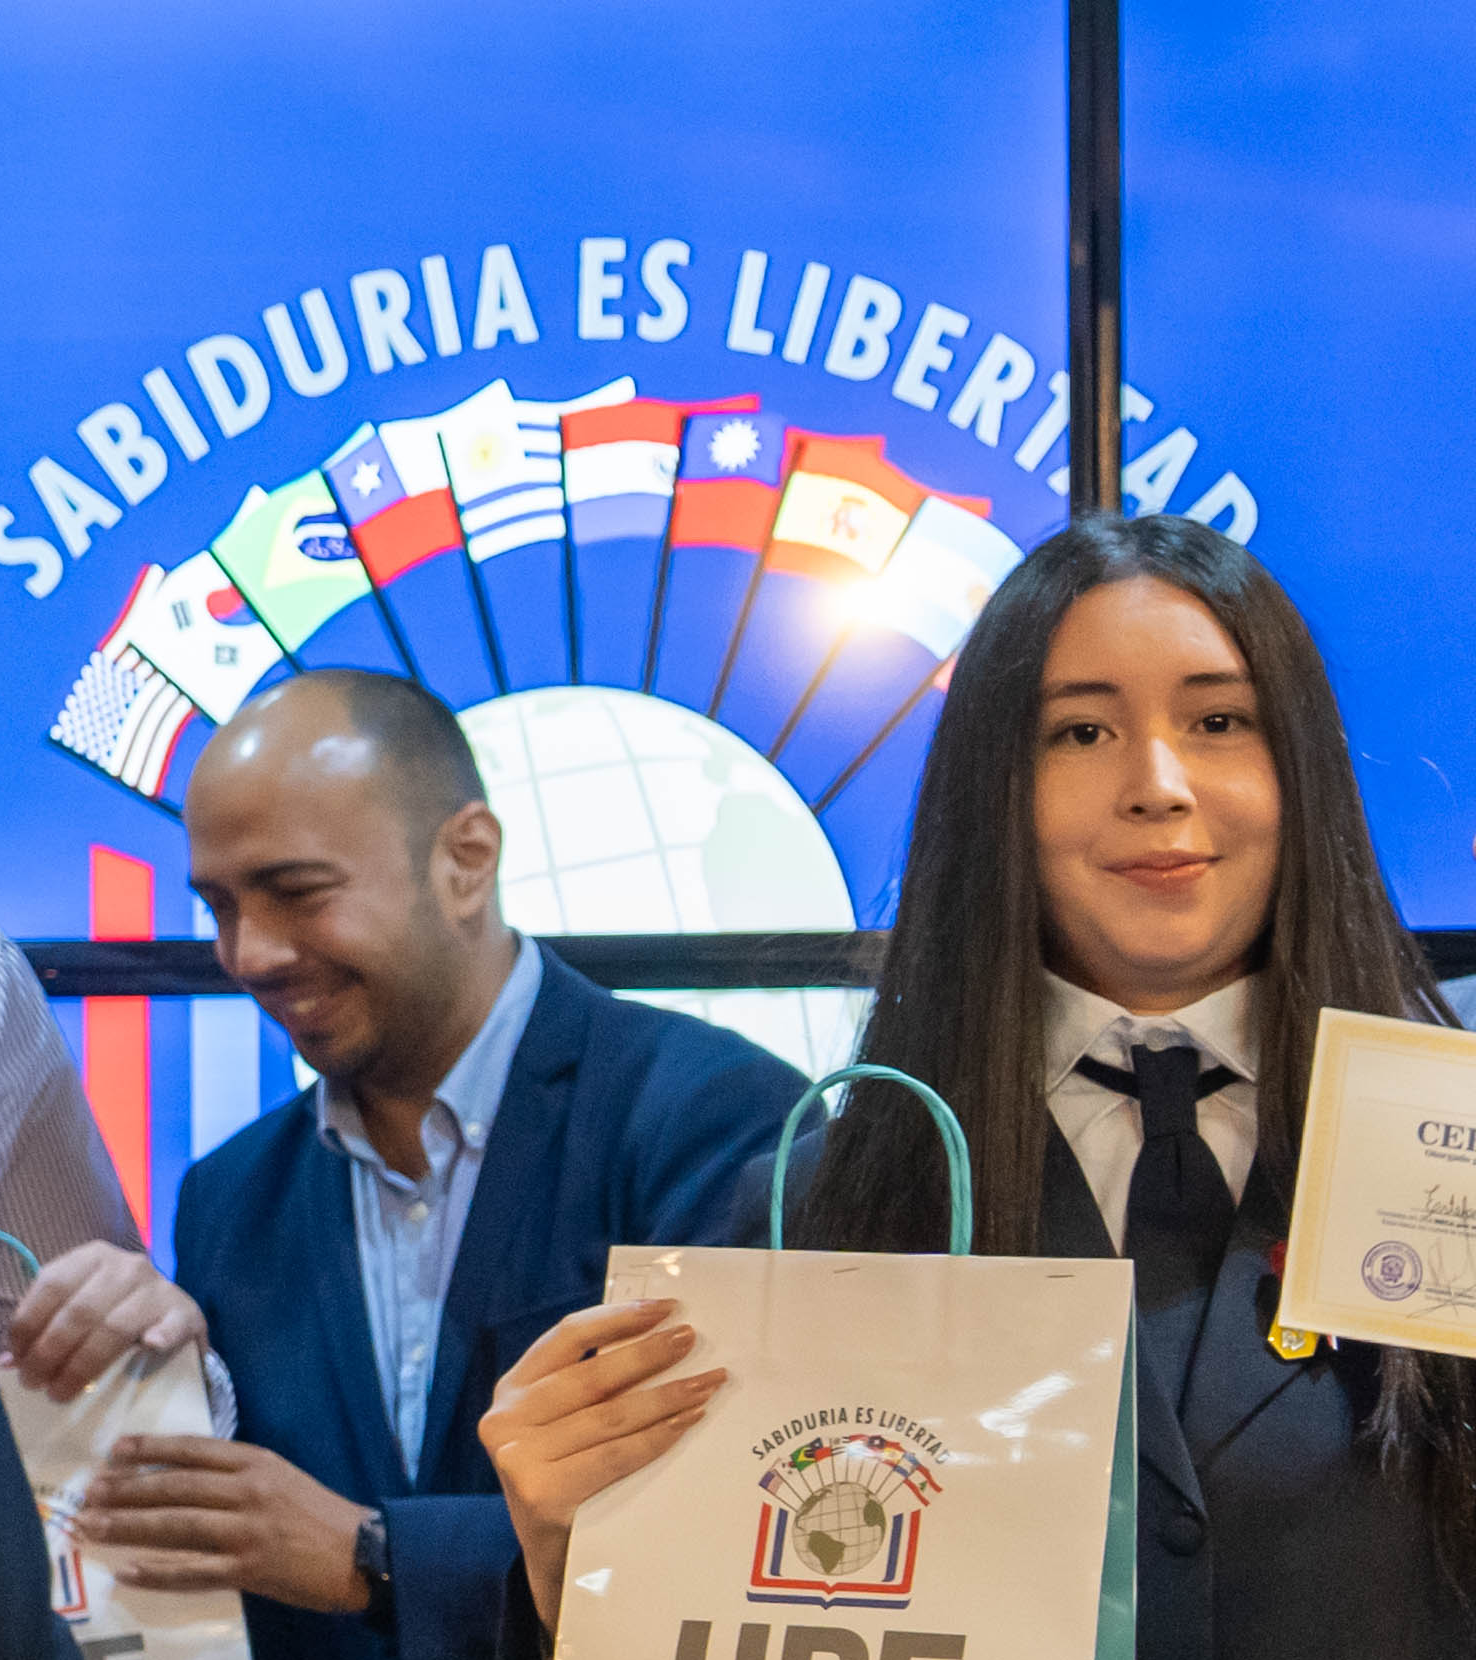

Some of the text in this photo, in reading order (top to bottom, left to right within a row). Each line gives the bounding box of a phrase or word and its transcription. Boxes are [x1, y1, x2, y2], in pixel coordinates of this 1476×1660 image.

[578, 237, 691, 343] ES
[726, 248, 1259, 546] LIBERTAD
[751, 1406, 953, 1465] SABIDURIA ES LIBERTAD
